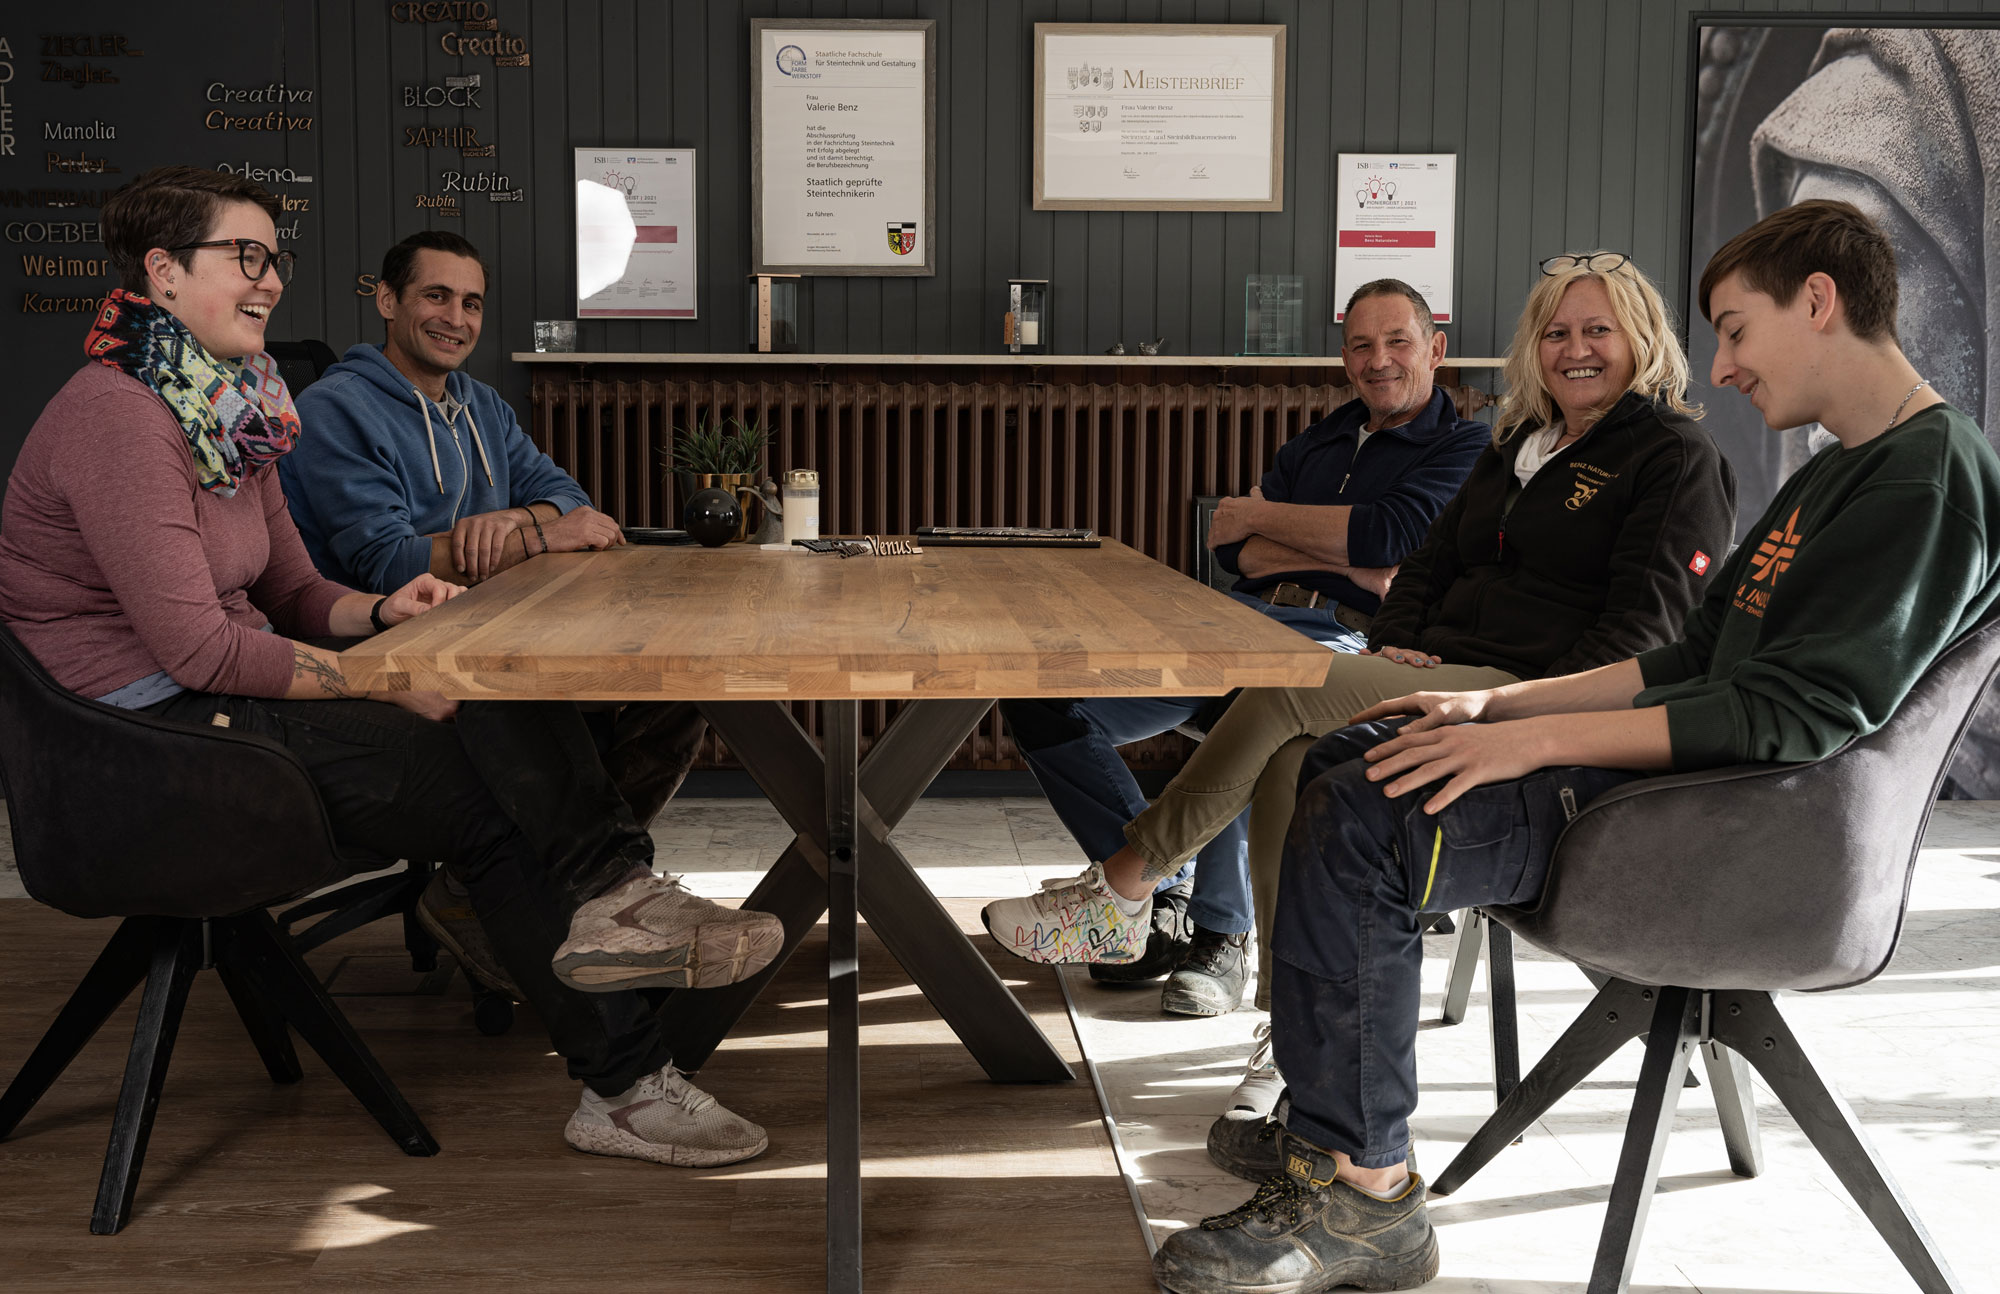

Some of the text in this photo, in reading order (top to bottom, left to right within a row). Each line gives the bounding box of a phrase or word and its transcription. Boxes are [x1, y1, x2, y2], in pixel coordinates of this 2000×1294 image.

[391, 1, 489, 23] CREATIO
[40, 35, 128, 56] ZIEGLER
[441, 32, 526, 56] Creatio
[815, 50, 882, 58] Staatliche Fachschule
[815, 59, 916, 69] für Steintechnik und Gestaltung
[1122, 69, 1245, 90] MEISTERBRIEF
[205, 82, 314, 103] Creativa
[404, 86, 480, 109] BLOCK
[806, 103, 858, 111] Valerie Benz
[44, 120, 116, 140] Manolia
[204, 109, 313, 131] Creativa
[404, 126, 480, 148] SAPHIR
[806, 132, 856, 140] Abschlussprüfung
[824, 140, 860, 148] Fachrichtung
[817, 147, 834, 155] Erfolg
[835, 147, 860, 155] abgelegt
[816, 162, 869, 170] Berufsbezeichnung
[441, 171, 510, 192] Rubin
[806, 177, 883, 188] Staatlich geprüfte
[415, 194, 456, 208] Rubin
[806, 189, 875, 198] Steintechnikerin
[22, 255, 108, 277] Weimar
[864, 534, 912, 557] Venus
